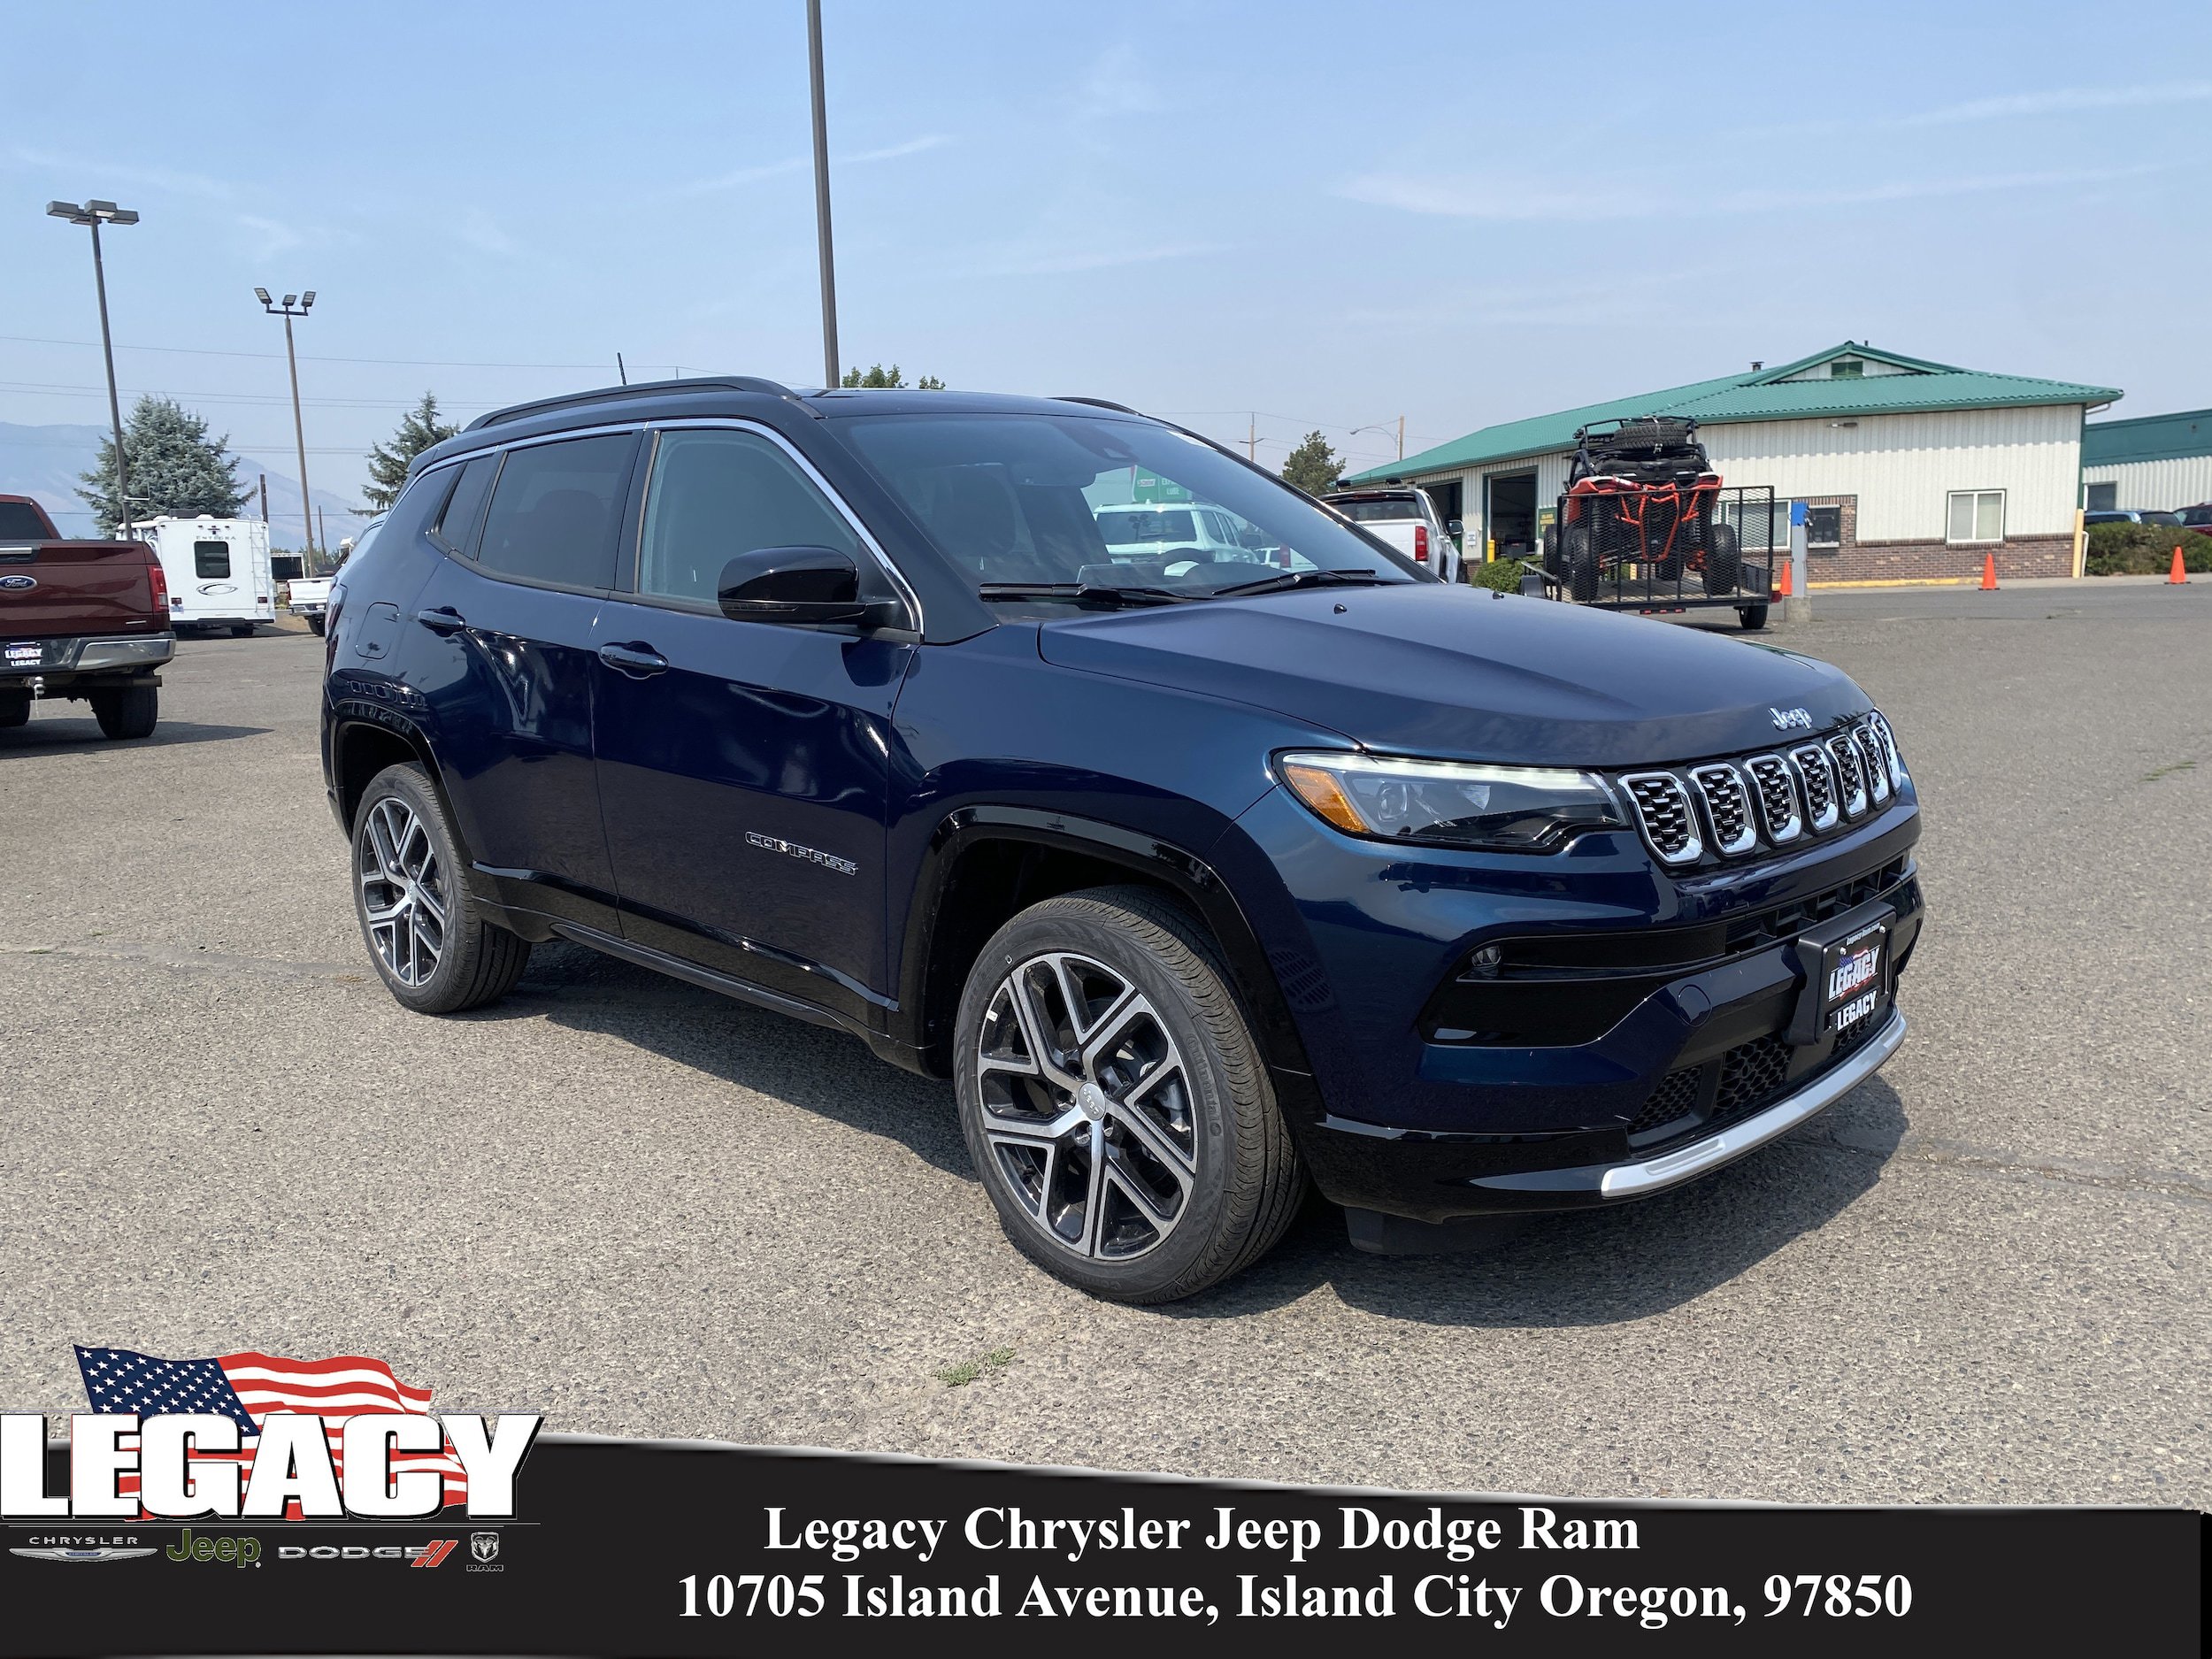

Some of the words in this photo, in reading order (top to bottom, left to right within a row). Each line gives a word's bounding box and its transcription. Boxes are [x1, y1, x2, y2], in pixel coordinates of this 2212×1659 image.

[5, 578, 27, 588] Ford
[4, 649, 42, 658] LEGACY
[1768, 707, 1813, 730] Jeep
[745, 831, 859, 876] COMPASS
[1829, 948, 1879, 999] LEGACY
[1837, 990, 1878, 1031] LEGACY
